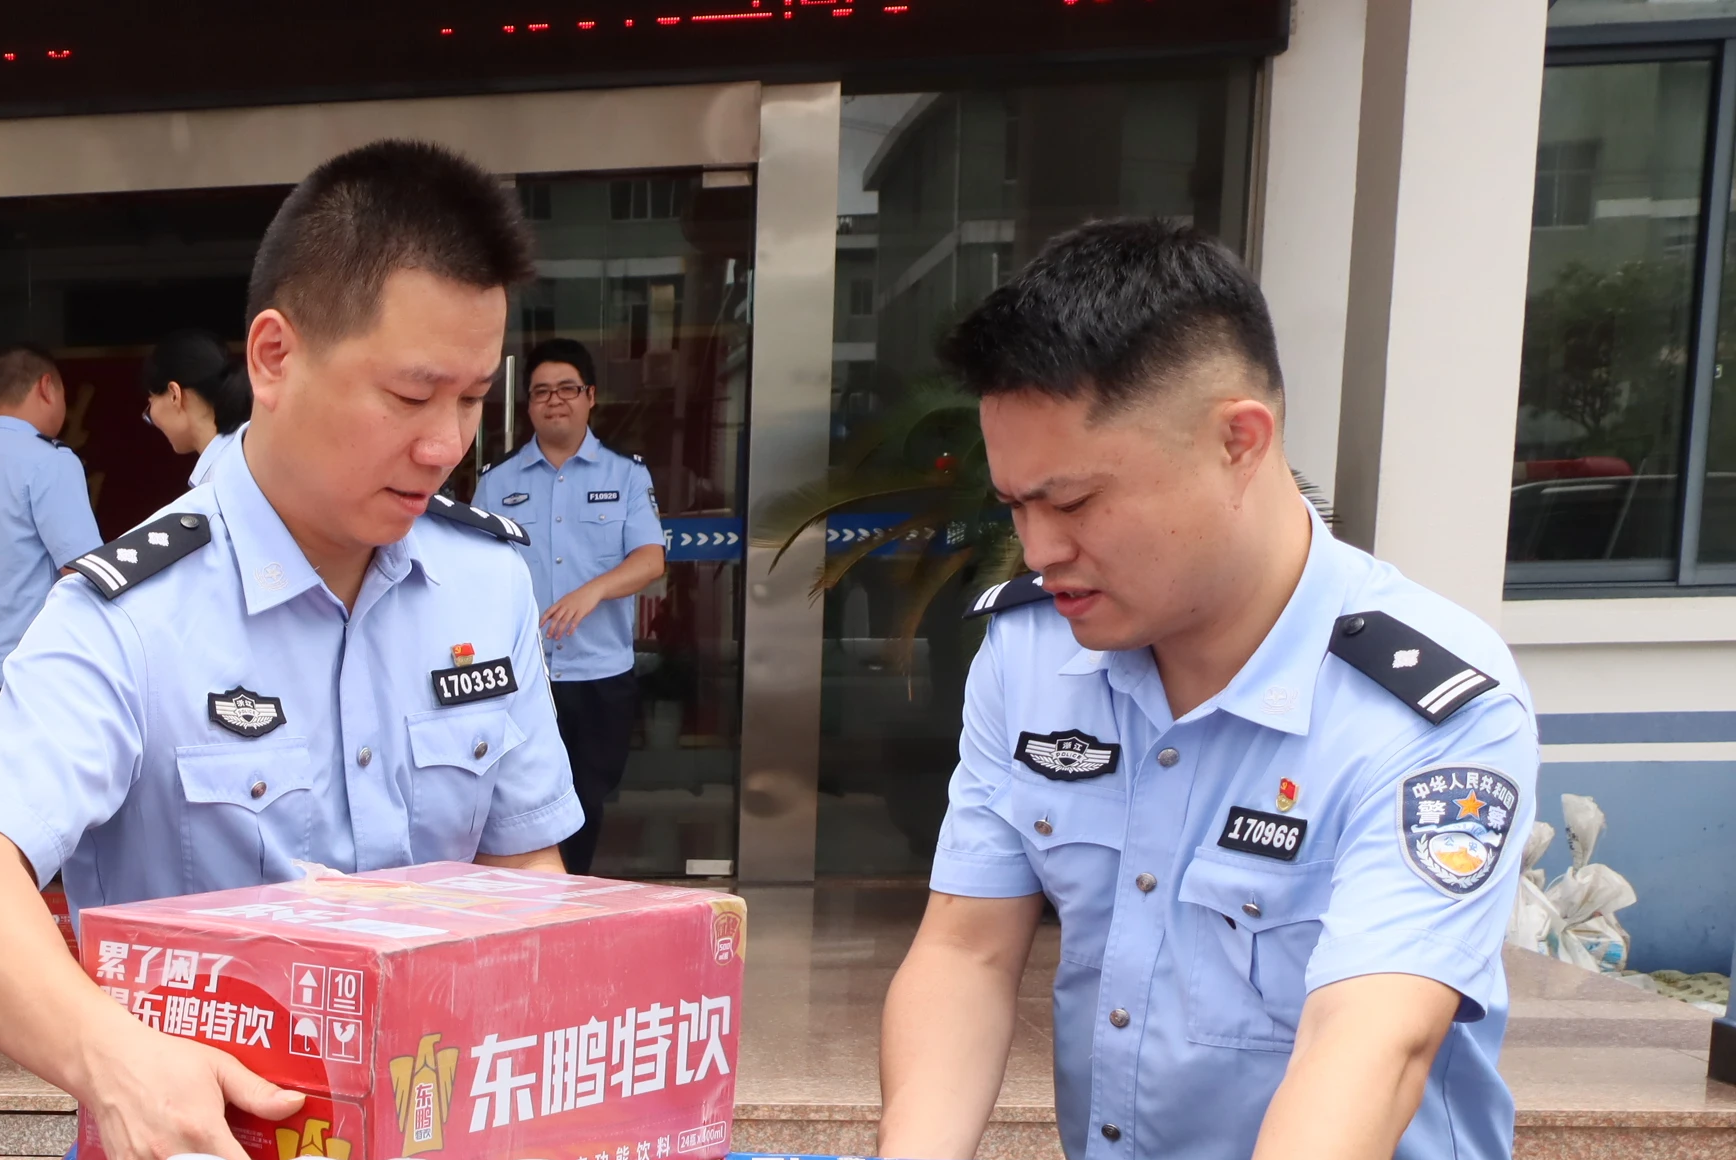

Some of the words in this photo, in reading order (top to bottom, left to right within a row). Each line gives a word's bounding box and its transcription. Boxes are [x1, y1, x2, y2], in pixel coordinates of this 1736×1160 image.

[439, 665, 509, 699] 170333
[1055, 751, 1083, 760] POLICE
[1062, 741, 1083, 752] 浙江
[1412, 771, 1515, 810] 中华人民共和国
[1227, 816, 1301, 852] 170966
[96, 940, 234, 993] 累了困了
[334, 973, 356, 999] 10
[100, 985, 274, 1049] 东鹏特饮
[468, 994, 731, 1133] 东鹏特饮
